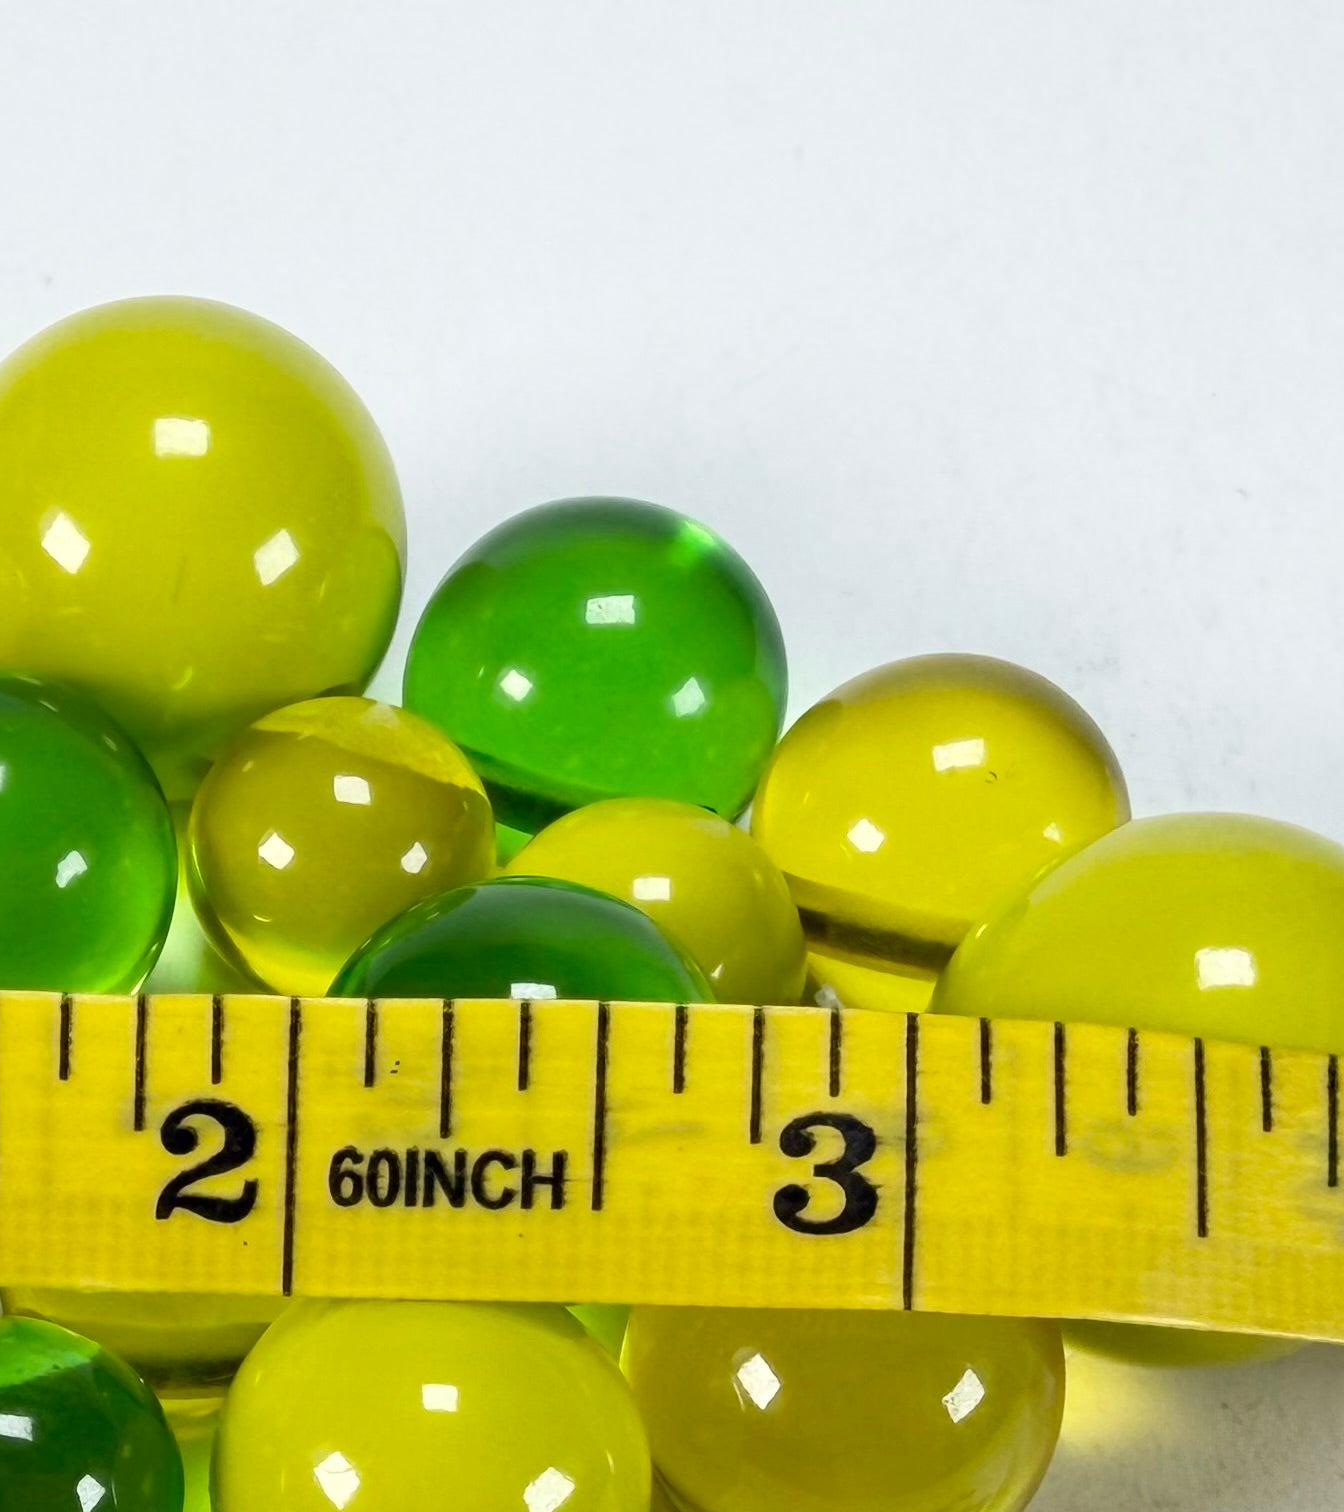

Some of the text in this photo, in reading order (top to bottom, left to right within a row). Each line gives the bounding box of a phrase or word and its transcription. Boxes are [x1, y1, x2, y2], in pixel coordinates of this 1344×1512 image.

[155, 1098, 259, 1224] 2
[328, 1145, 569, 1211] 60INCH
[773, 1111, 881, 1236] 3
